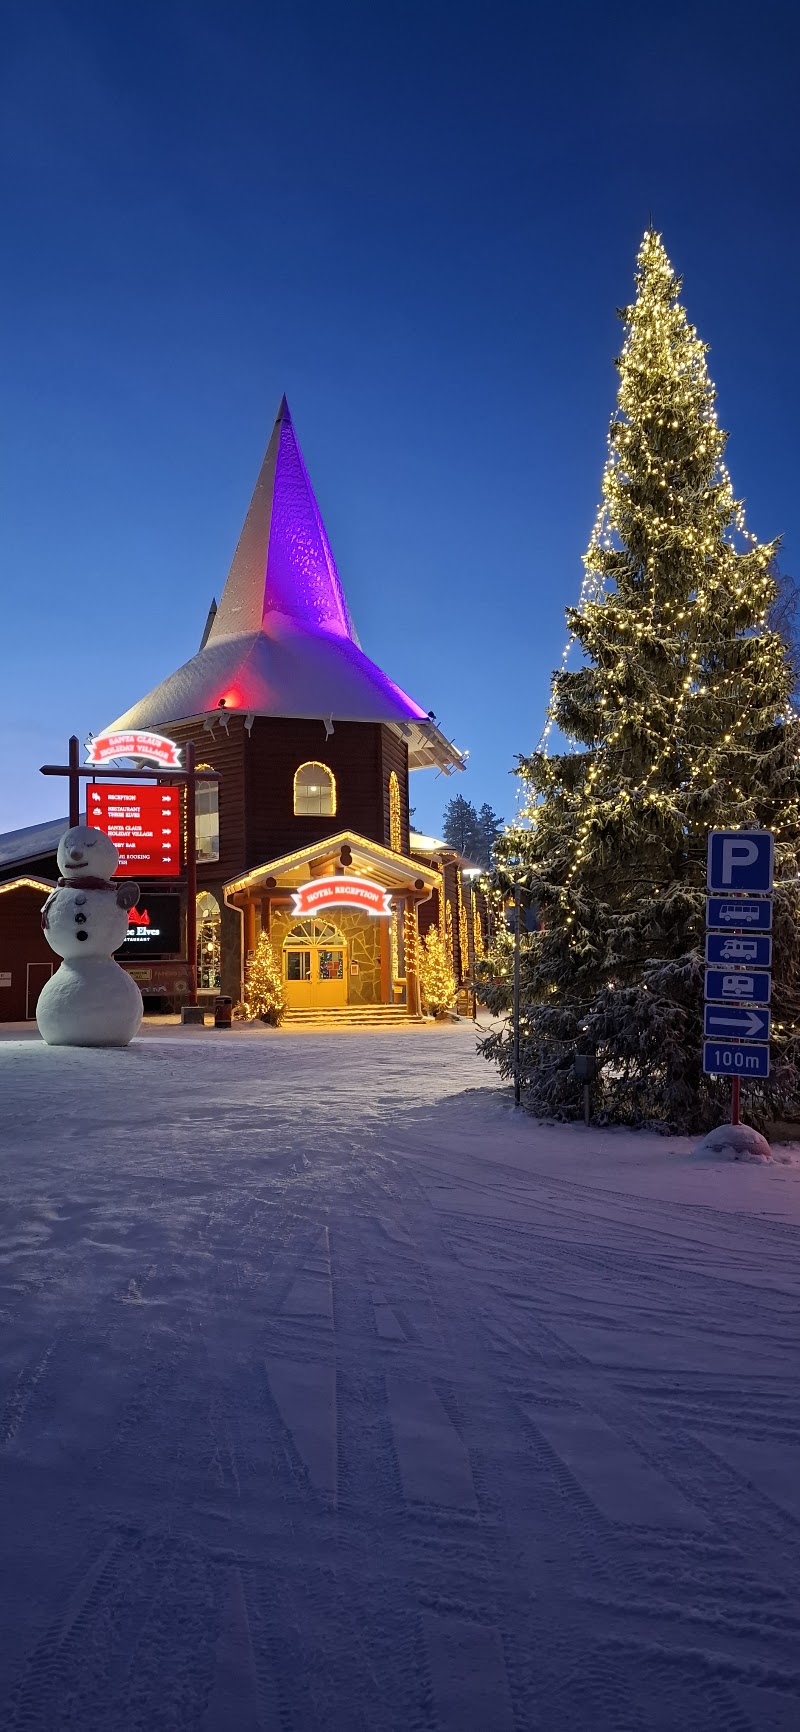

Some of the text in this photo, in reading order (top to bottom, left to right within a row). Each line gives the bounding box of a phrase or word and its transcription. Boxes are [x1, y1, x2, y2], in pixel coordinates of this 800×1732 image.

[108, 735, 162, 748] SANTA CLAUS
[99, 745, 169, 759] HOLIDAY VILLAGE
[722, 839, 759, 884] P
[306, 886, 380, 903] HOTEL RECEPTION
[136, 926, 160, 936] Elves
[714, 1050, 760, 1069] 100m
